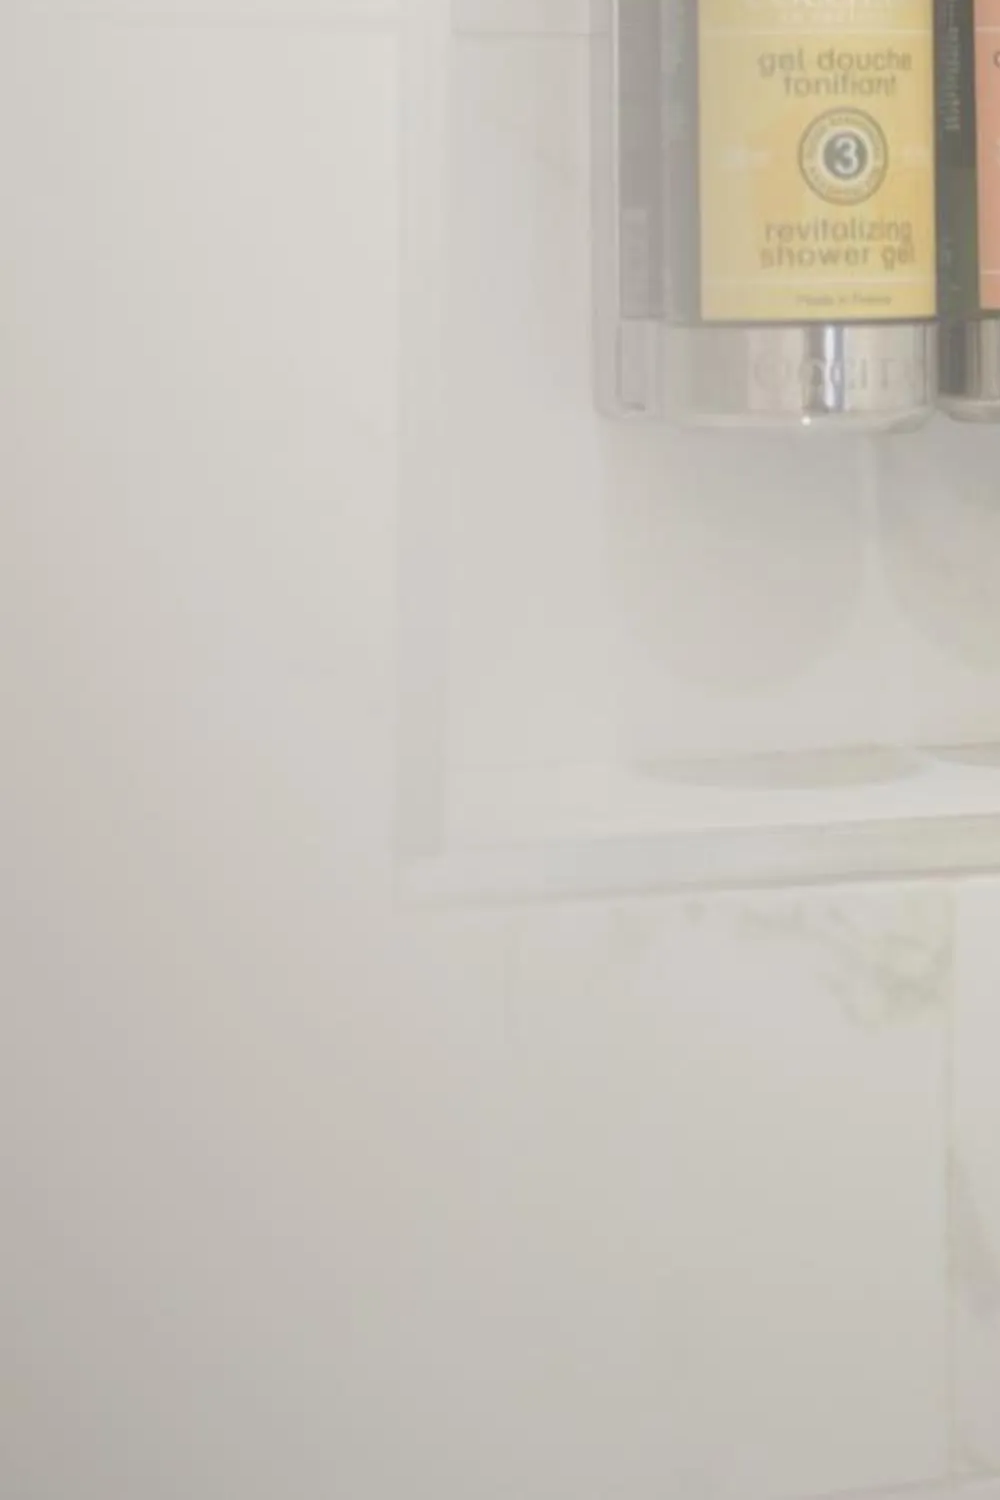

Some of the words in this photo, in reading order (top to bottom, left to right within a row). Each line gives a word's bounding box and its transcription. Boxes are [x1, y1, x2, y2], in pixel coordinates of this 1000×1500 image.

[757, 47, 805, 78] gel
[816, 47, 913, 72] douche
[783, 72, 898, 98] tonifiant
[833, 137, 860, 175] 3
[764, 216, 913, 245] revitalizing
[758, 243, 870, 270] shower
[880, 239, 917, 272] gel
